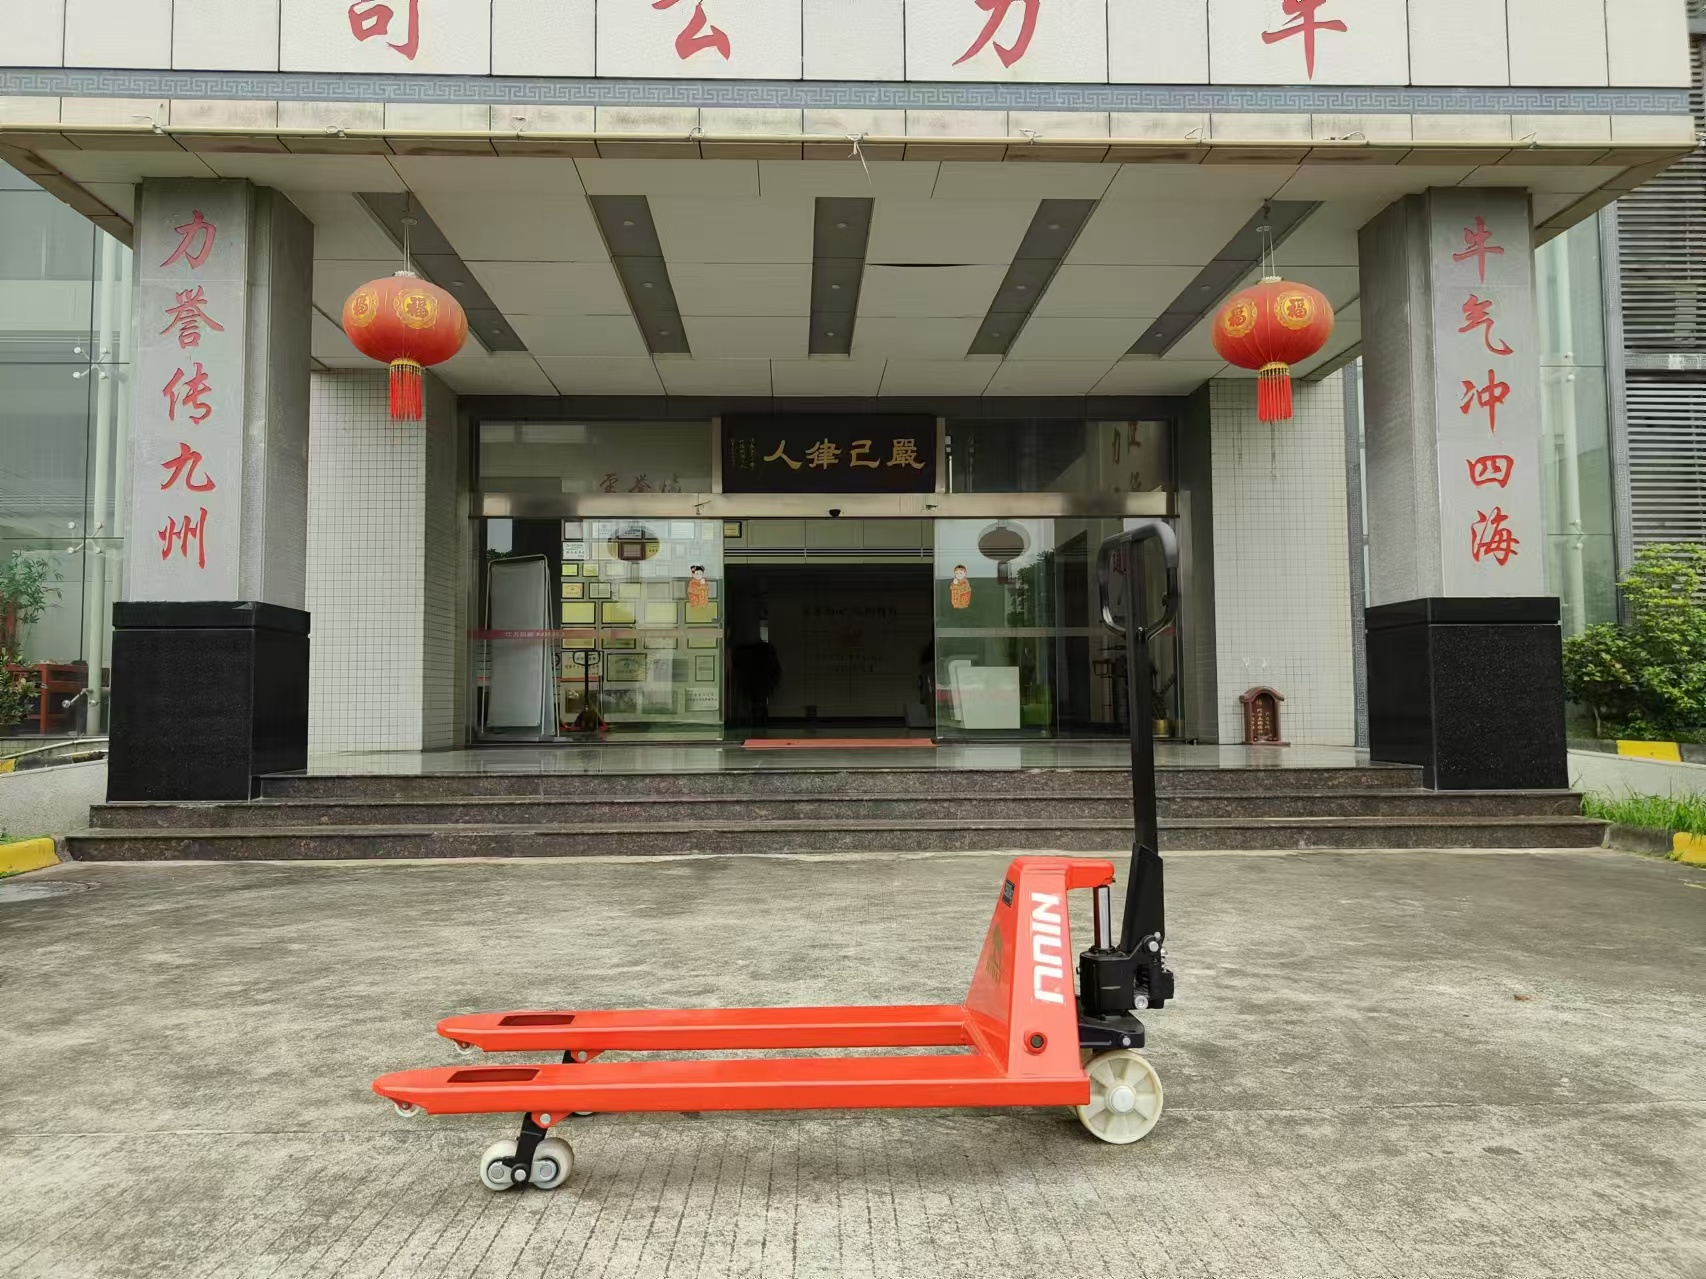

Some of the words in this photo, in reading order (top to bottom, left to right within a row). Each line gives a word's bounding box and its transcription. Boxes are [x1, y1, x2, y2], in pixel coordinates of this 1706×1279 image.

[157, 209, 225, 570] 力誉传九州
[1452, 215, 1520, 567] 牛气冲四海
[1032, 892, 1064, 1004] NIULI
